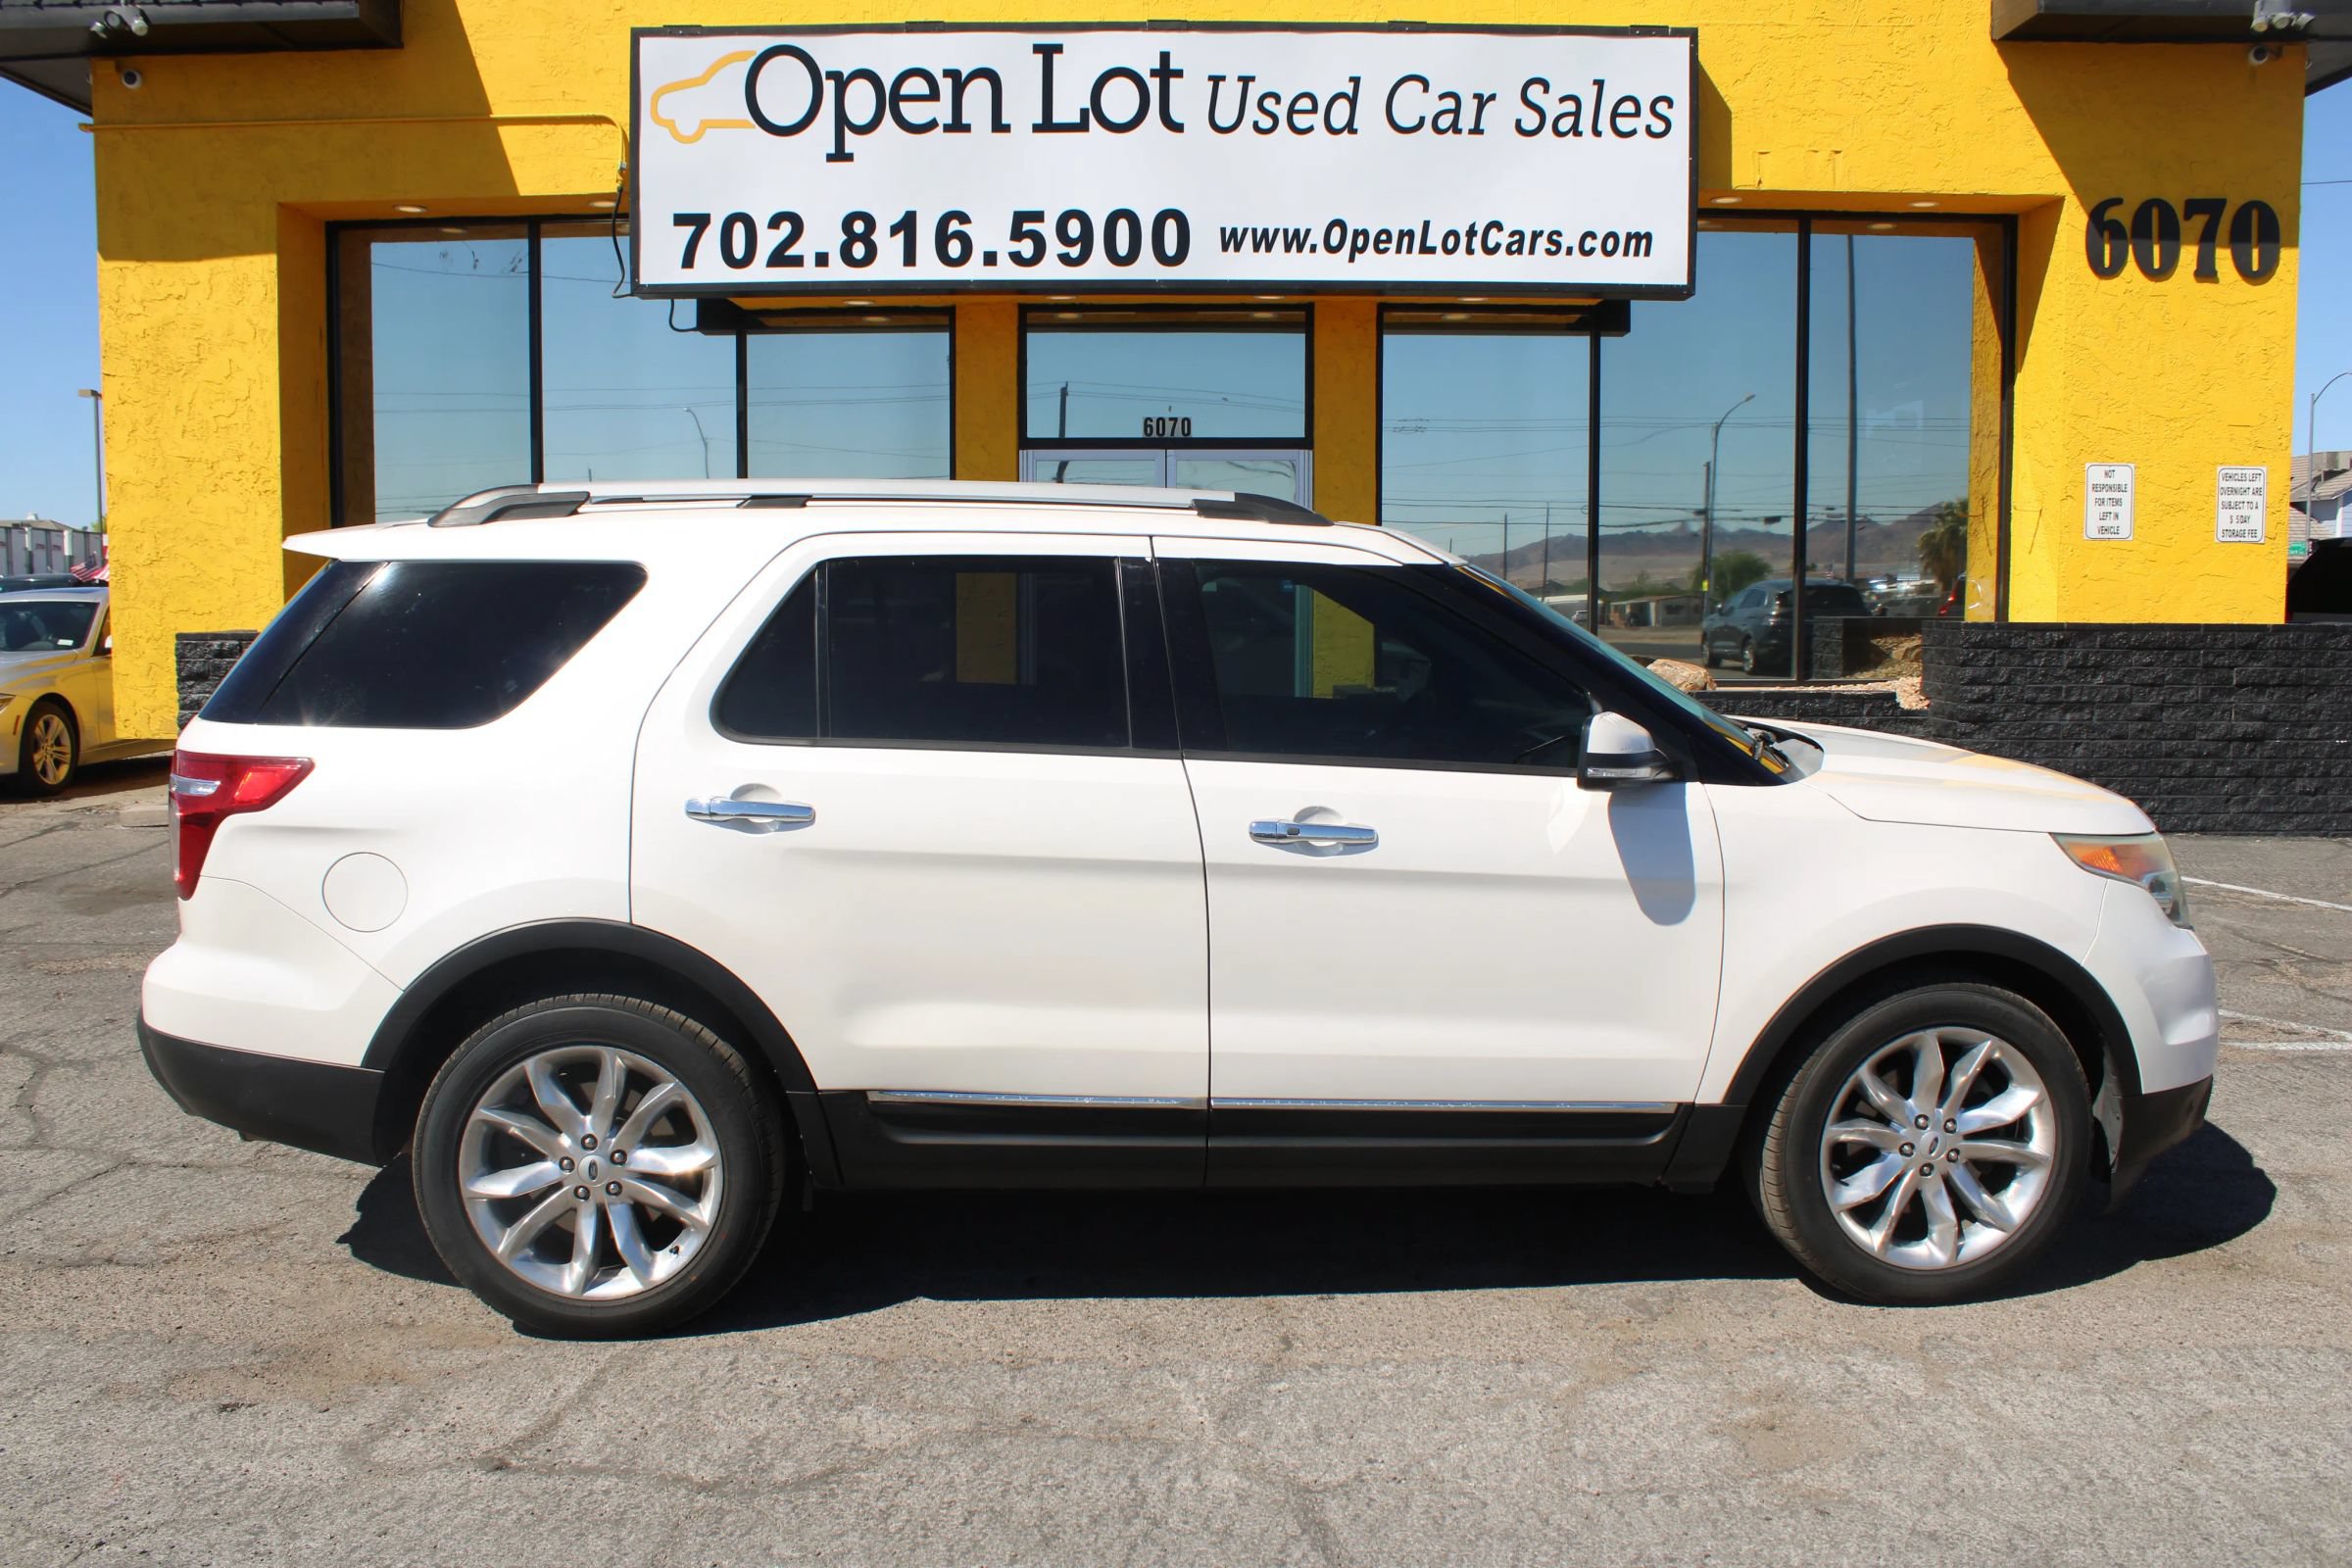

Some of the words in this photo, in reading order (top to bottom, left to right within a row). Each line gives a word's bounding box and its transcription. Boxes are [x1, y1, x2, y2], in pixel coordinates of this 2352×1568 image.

[745, 43, 1011, 164] Open
[1031, 42, 1186, 134] Lot
[1206, 74, 1361, 135] Used
[1385, 74, 1496, 135] Car
[1514, 76, 1674, 139] Sales
[671, 208, 1192, 270] 702.816.5900
[1219, 218, 1652, 263] www.OpenLotCars.com
[2085, 197, 2280, 286] 6070
[1143, 416, 1193, 438] 6070
[2104, 469, 2115, 478] NOT
[2222, 472, 2247, 481] VEHICLES
[2248, 472, 2262, 481] LEFT
[2091, 483, 2128, 492] RESPONSIBLE
[2220, 487, 2250, 496] OVERNIGHT
[2252, 487, 2262, 496] ARE
[2094, 497, 2105, 507] FOR
[2106, 497, 2123, 507] ITEMS
[2221, 501, 2245, 510] SUBJECT
[2246, 501, 2253, 510] TO
[2255, 501, 2259, 510] A
[2099, 512, 2112, 520] LEFT
[2113, 512, 2119, 520] IN
[2222, 528, 2245, 538] STORAGE
[2247, 528, 2258, 538] FEE
